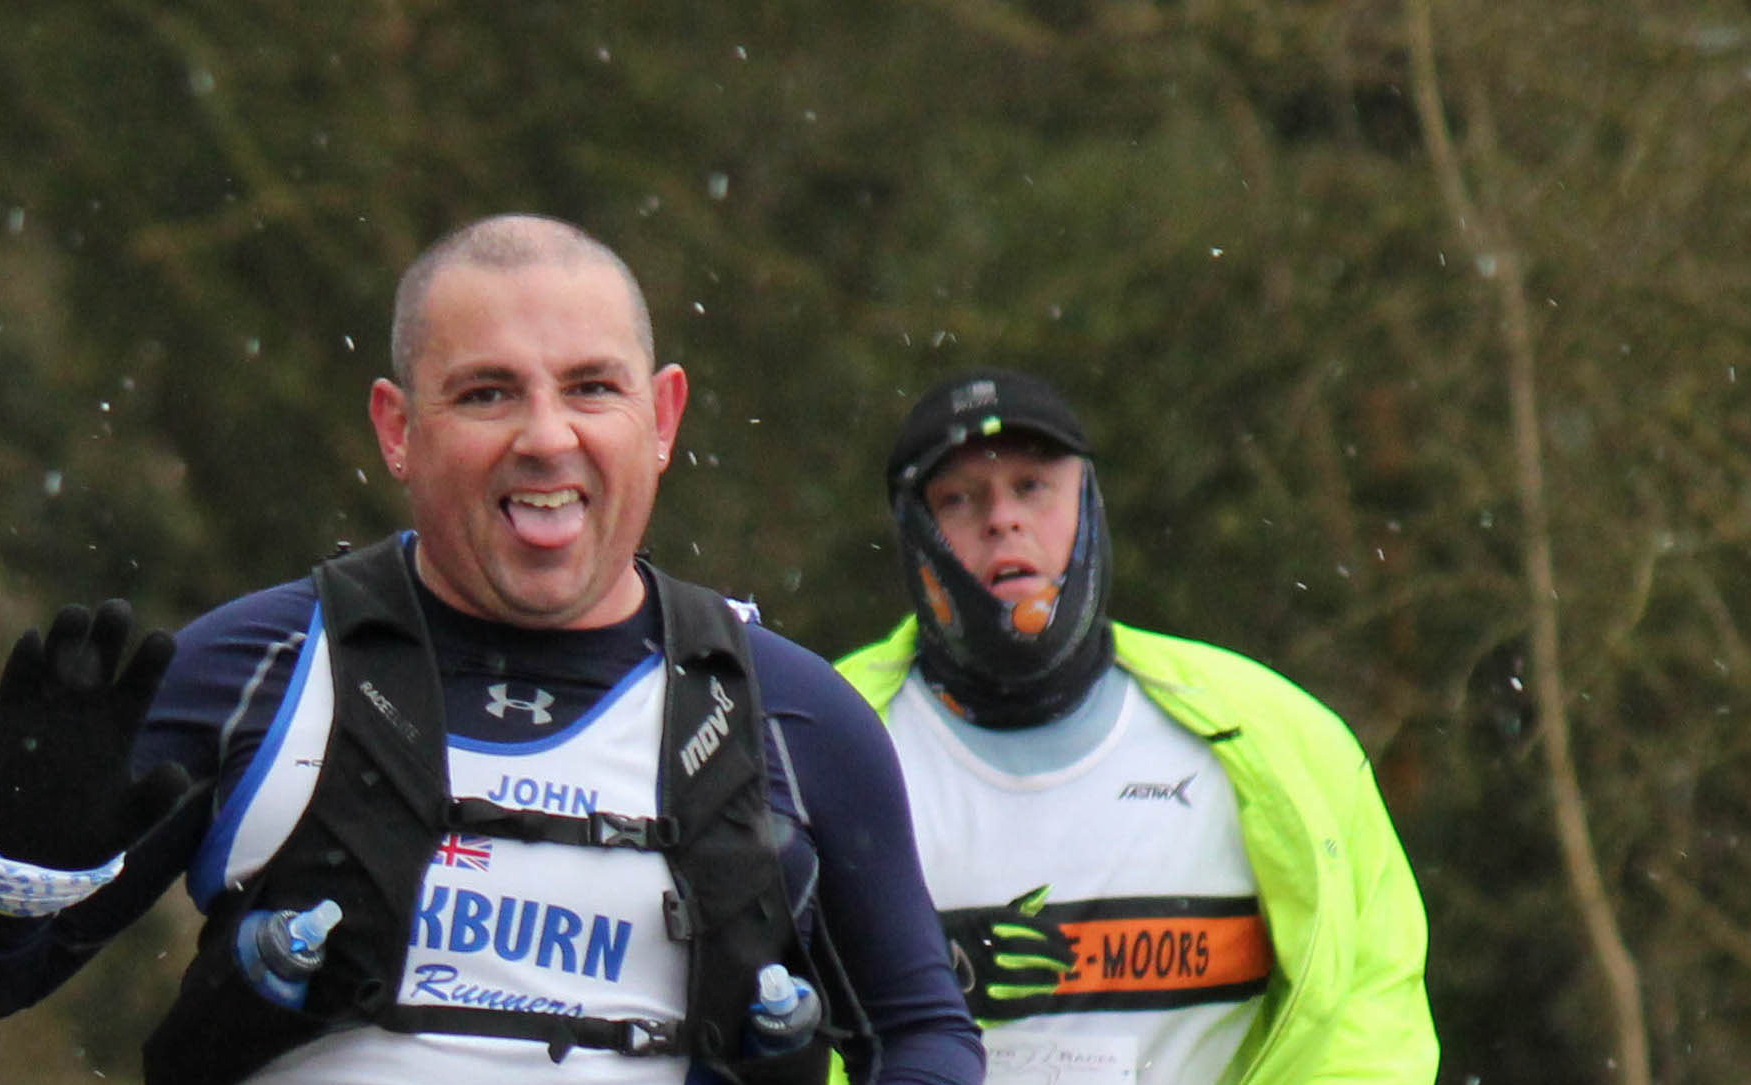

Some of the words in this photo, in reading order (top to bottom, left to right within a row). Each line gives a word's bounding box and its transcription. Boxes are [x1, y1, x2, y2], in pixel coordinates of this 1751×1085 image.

[486, 775, 599, 815] JOHN
[408, 885, 633, 983] KBURN
[411, 963, 585, 1018] Runners
